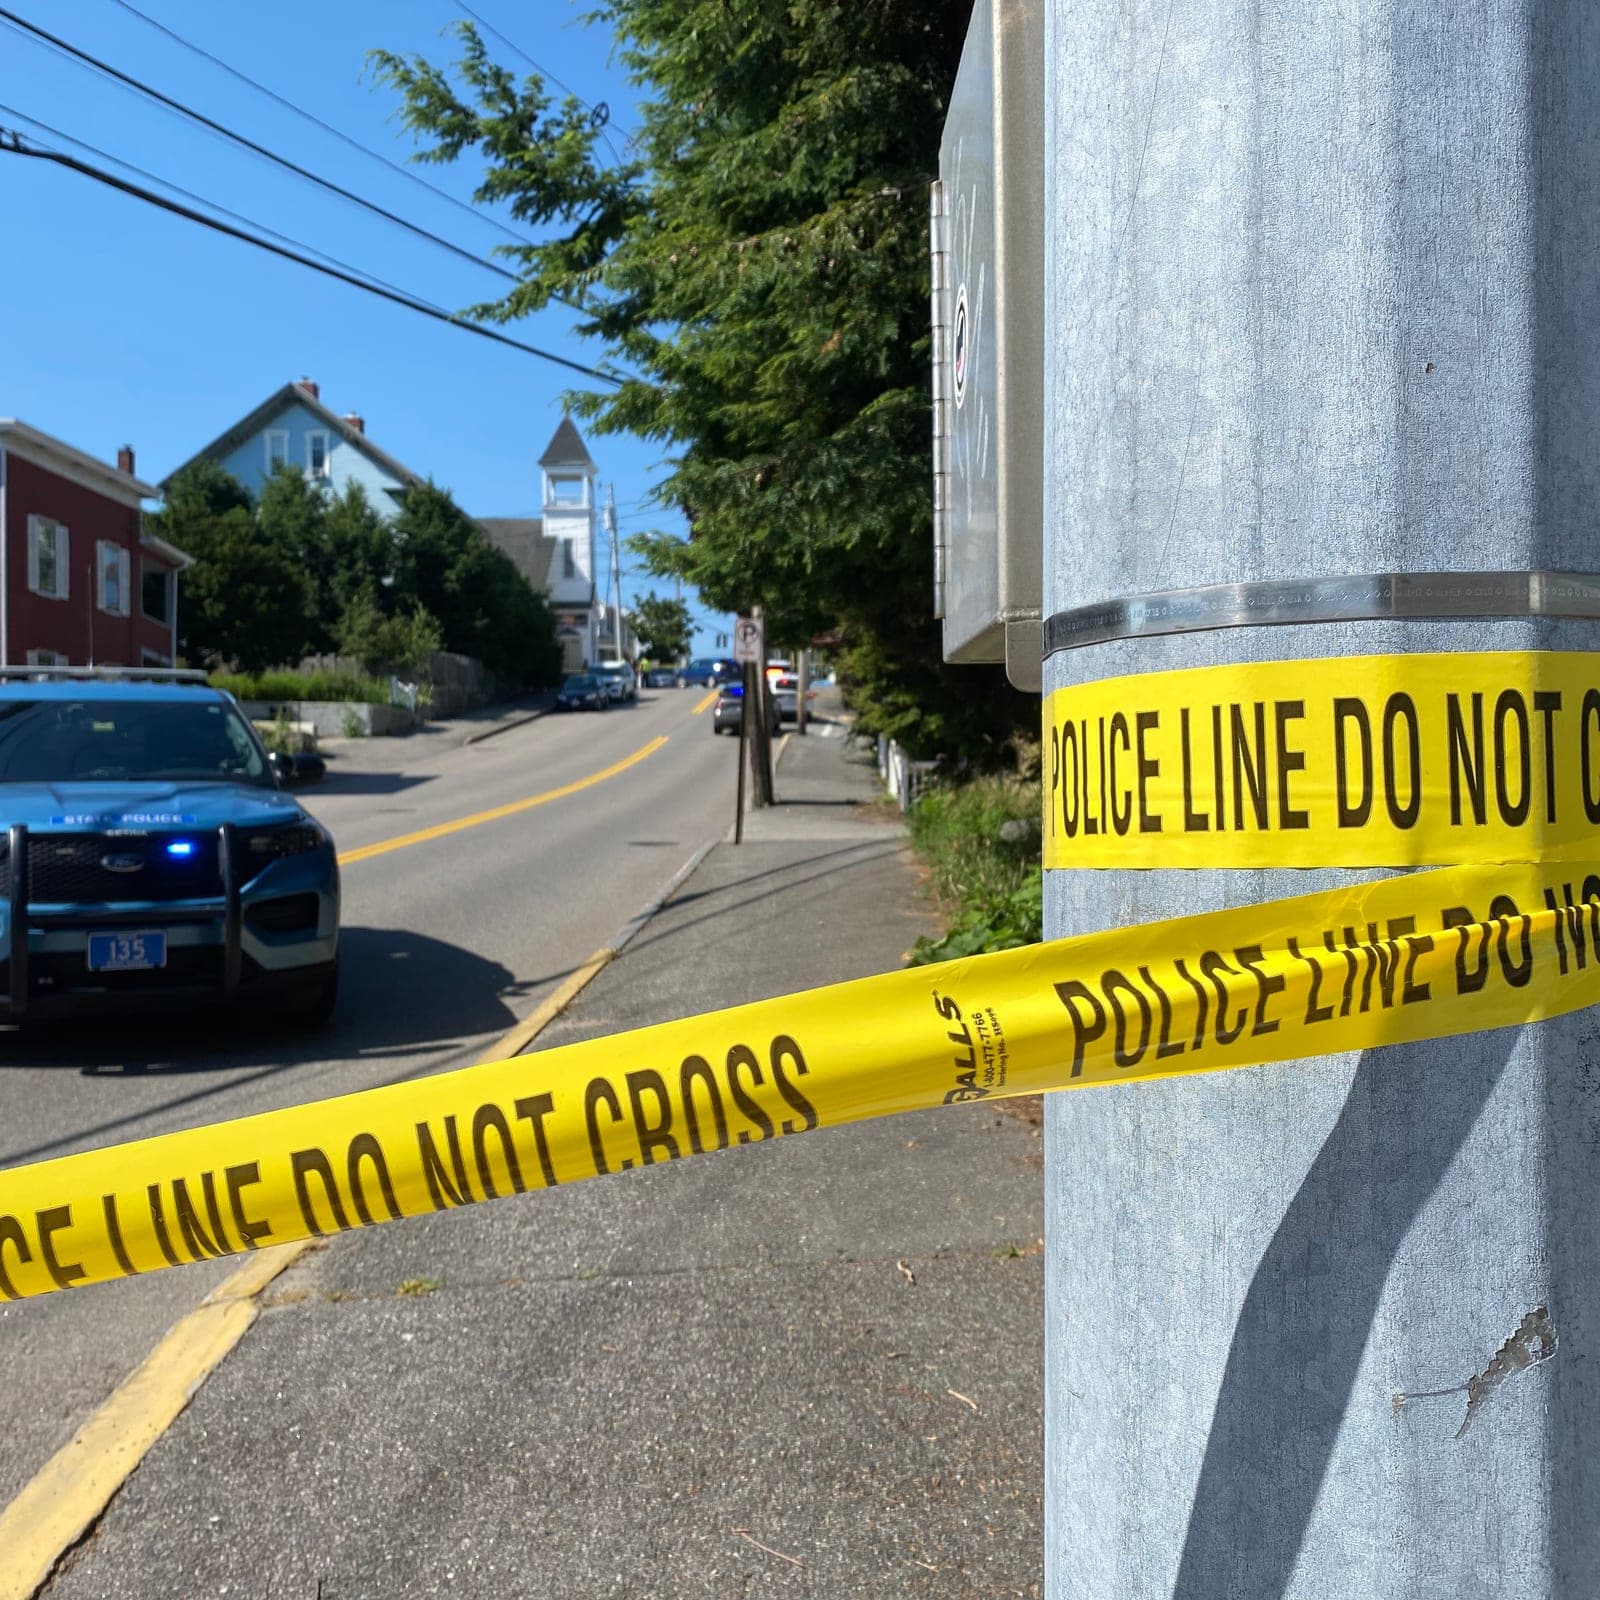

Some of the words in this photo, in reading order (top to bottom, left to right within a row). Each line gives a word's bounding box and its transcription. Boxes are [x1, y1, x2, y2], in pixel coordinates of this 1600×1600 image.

[121, 813, 183, 824] POLICE
[1052, 711, 1163, 838] POLICE
[1180, 700, 1309, 831] LINE
[1333, 691, 1421, 830] DO
[1446, 688, 1562, 827] NOT
[109, 939, 145, 961] 135
[1053, 944, 1285, 1078] POLICE
[1287, 912, 1435, 1025] LINE
[1441, 895, 1532, 994] DO
[971, 1012, 994, 1088] 1-800-477-7766
[0, 1204, 87, 1300] CE
[102, 1161, 273, 1275] LINE
[290, 1132, 403, 1237] DO
[415, 1091, 558, 1211] NOT
[585, 1034, 820, 1176] CROSS
